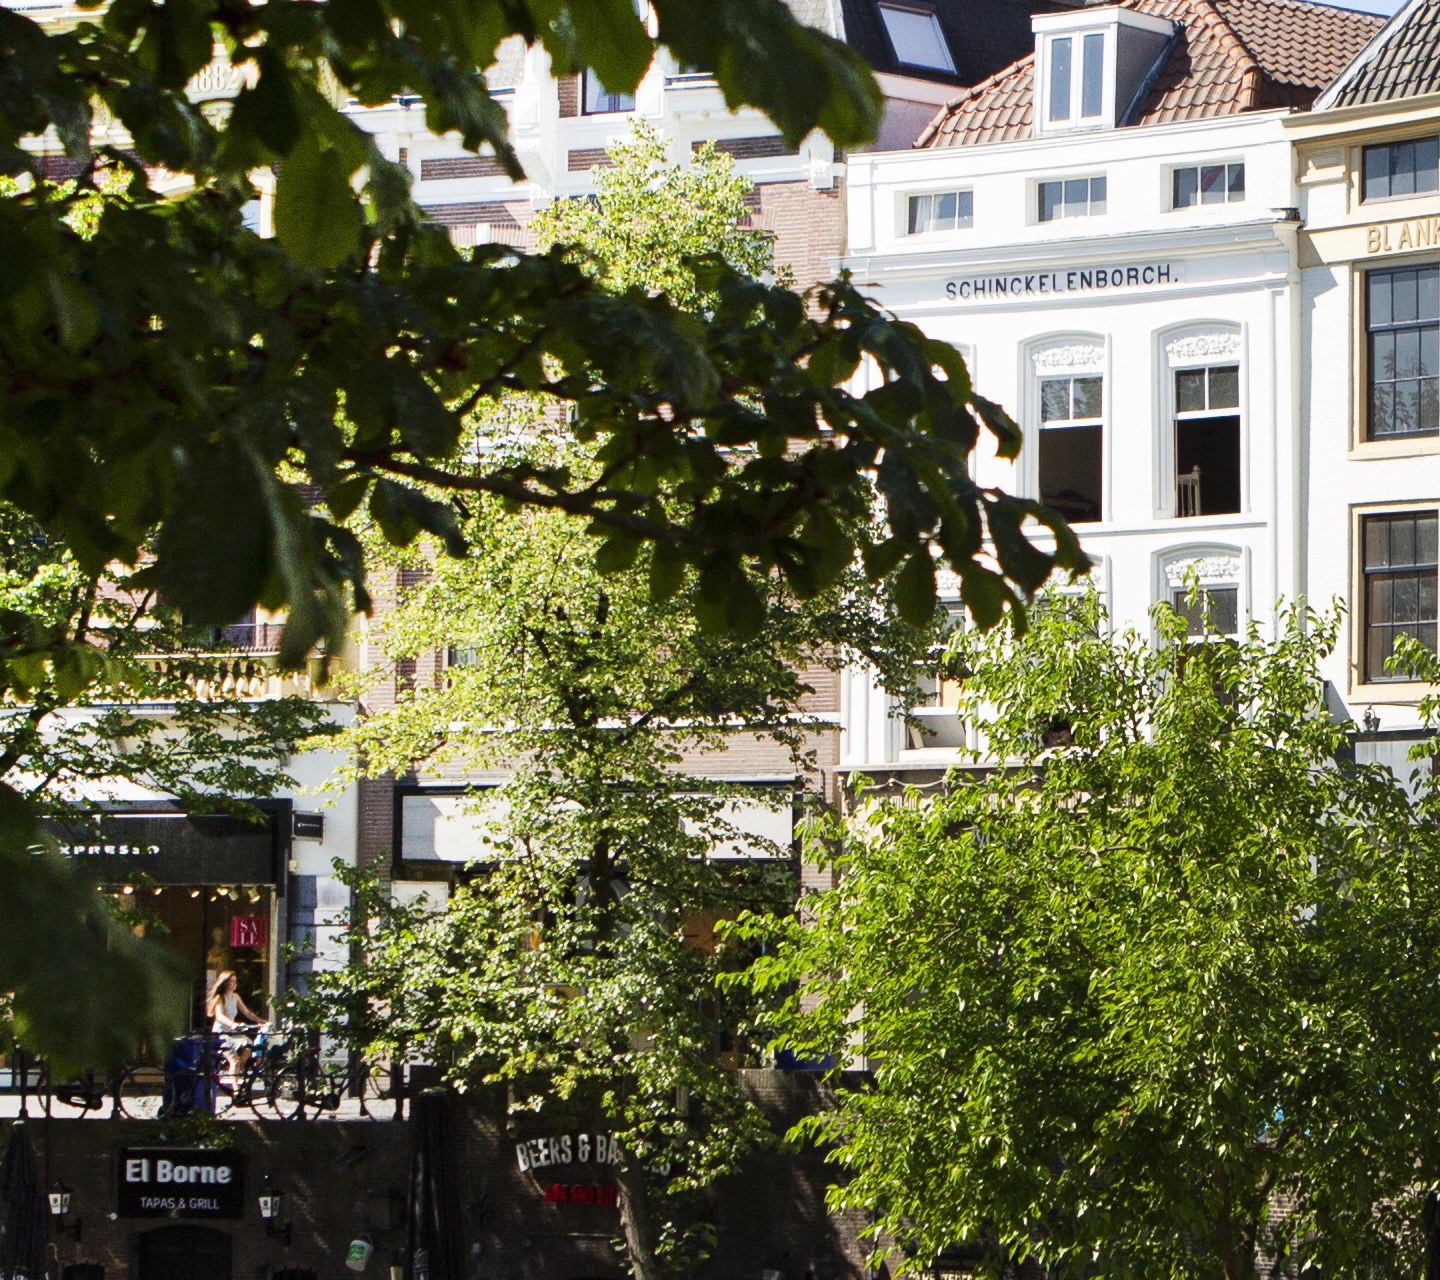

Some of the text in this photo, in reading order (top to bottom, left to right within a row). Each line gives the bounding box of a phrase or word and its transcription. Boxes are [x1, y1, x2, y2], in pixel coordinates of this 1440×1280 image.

[946, 264, 1180, 301] SCHINCKELENBORCH.
[516, 1134, 572, 1172] BEERS
[578, 1133, 591, 1162] &
[126, 1159, 232, 1184] El Borne
[141, 1197, 219, 1210] TAPAS & GRILL
